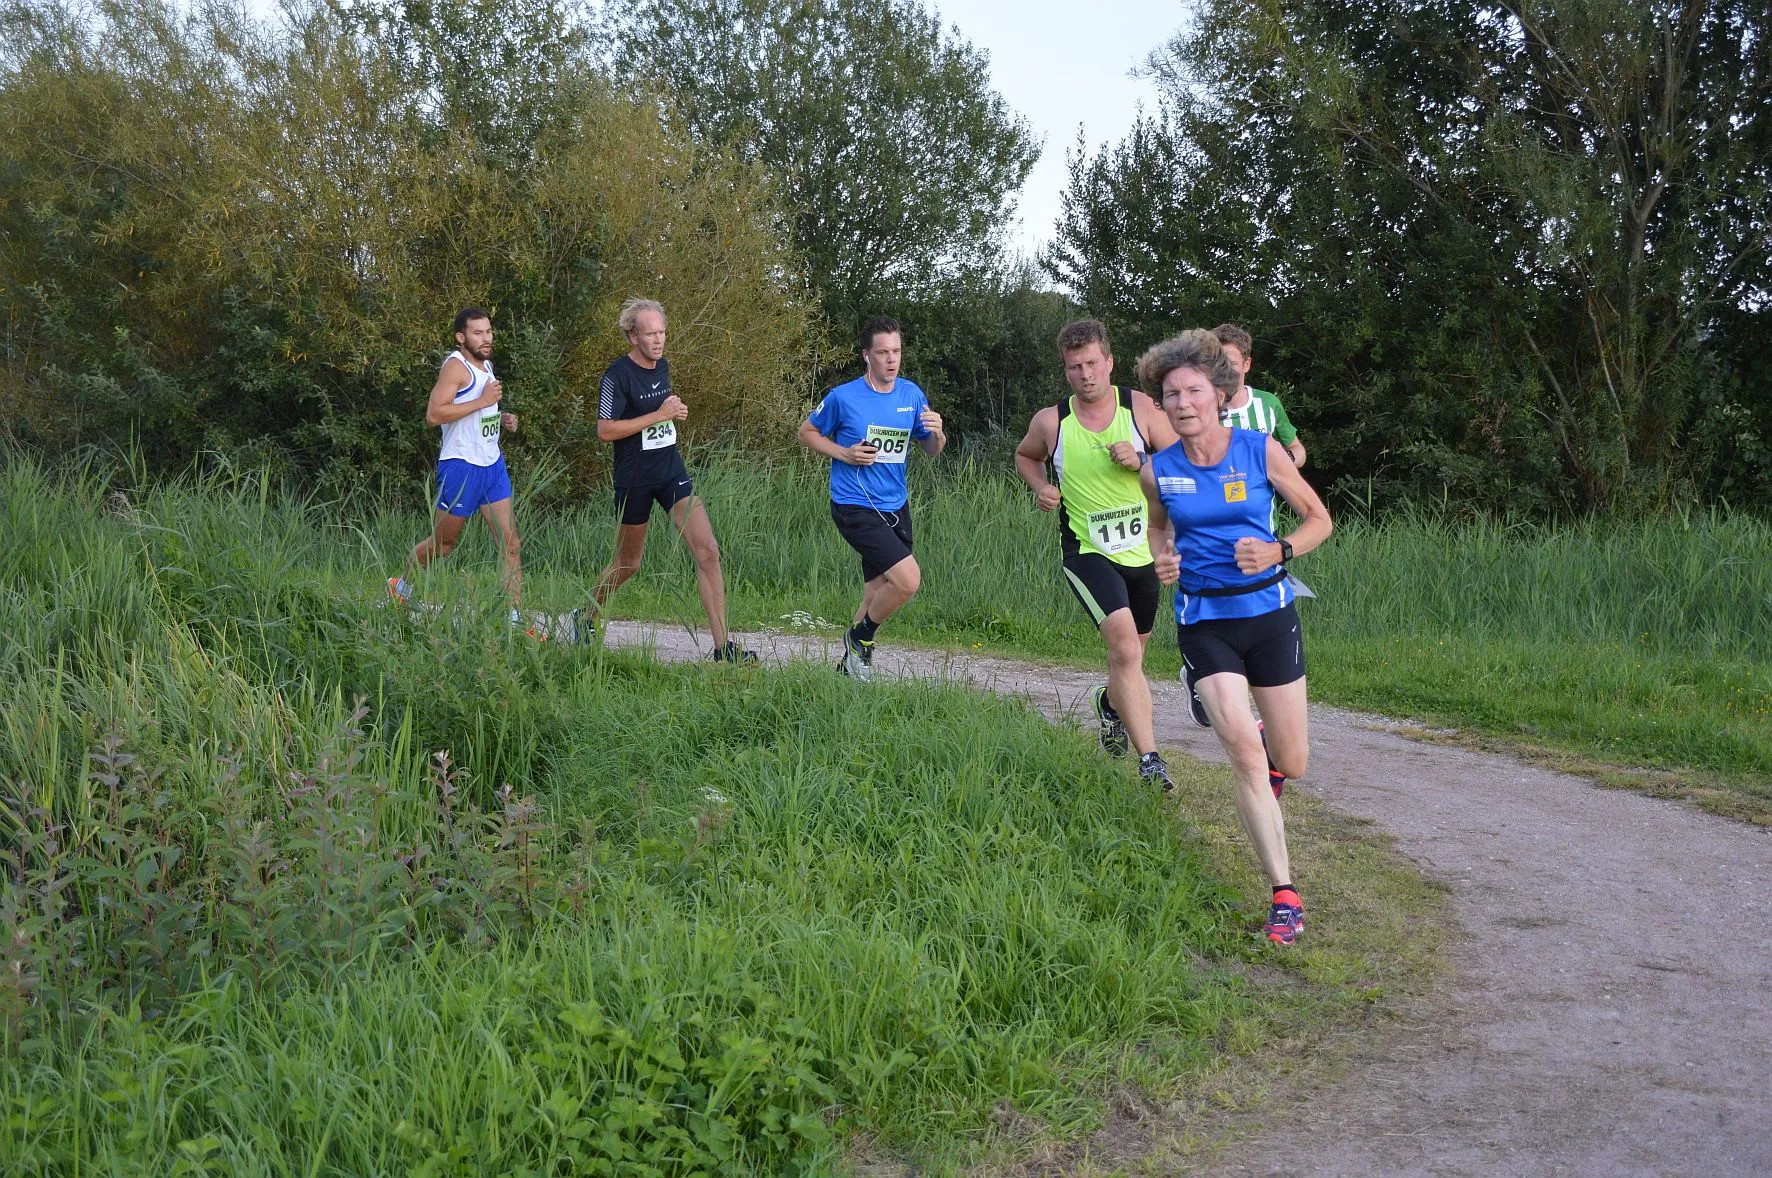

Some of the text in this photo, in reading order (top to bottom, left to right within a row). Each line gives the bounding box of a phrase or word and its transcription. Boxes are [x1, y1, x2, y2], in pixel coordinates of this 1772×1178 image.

[646, 422, 673, 441] 234
[870, 437, 905, 454] 005
[1097, 517, 1142, 544] 116
